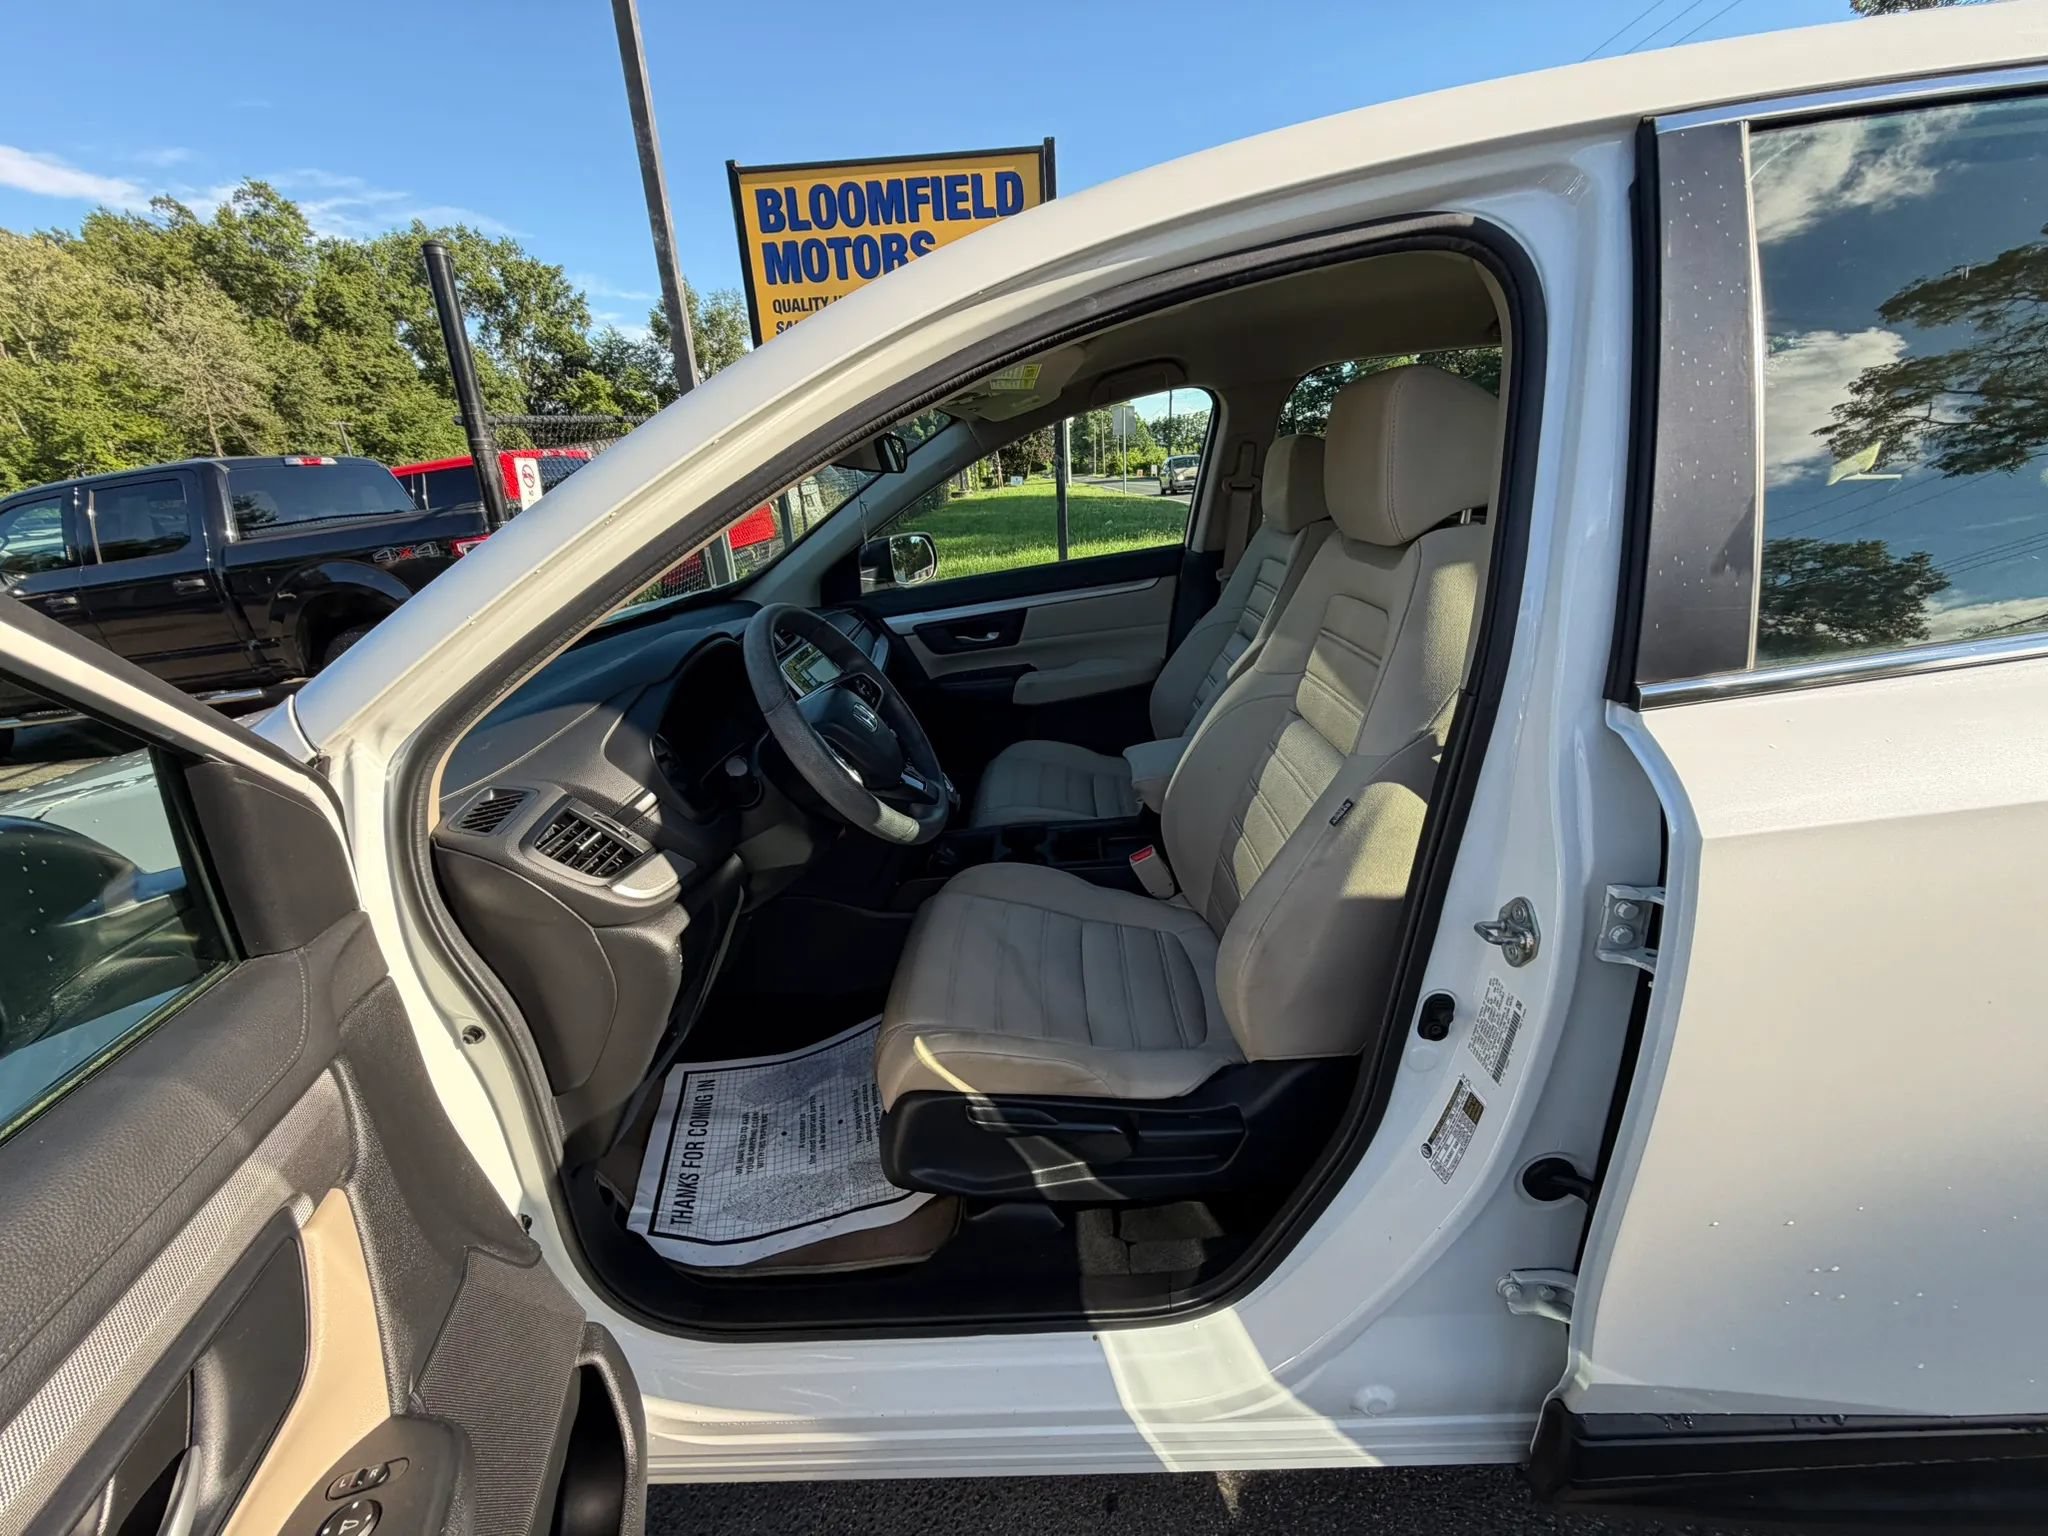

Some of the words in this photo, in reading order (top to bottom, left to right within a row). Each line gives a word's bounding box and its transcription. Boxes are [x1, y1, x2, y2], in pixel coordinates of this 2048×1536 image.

[754, 171, 1024, 234] BLOOMFIELD
[697, 1079, 716, 1092] IN
[688, 1094, 713, 1137] COMING
[681, 1141, 705, 1168] FOR
[670, 1172, 700, 1224] THANKS
[339, 1479, 346, 1488] L
[369, 1468, 378, 1478] R
